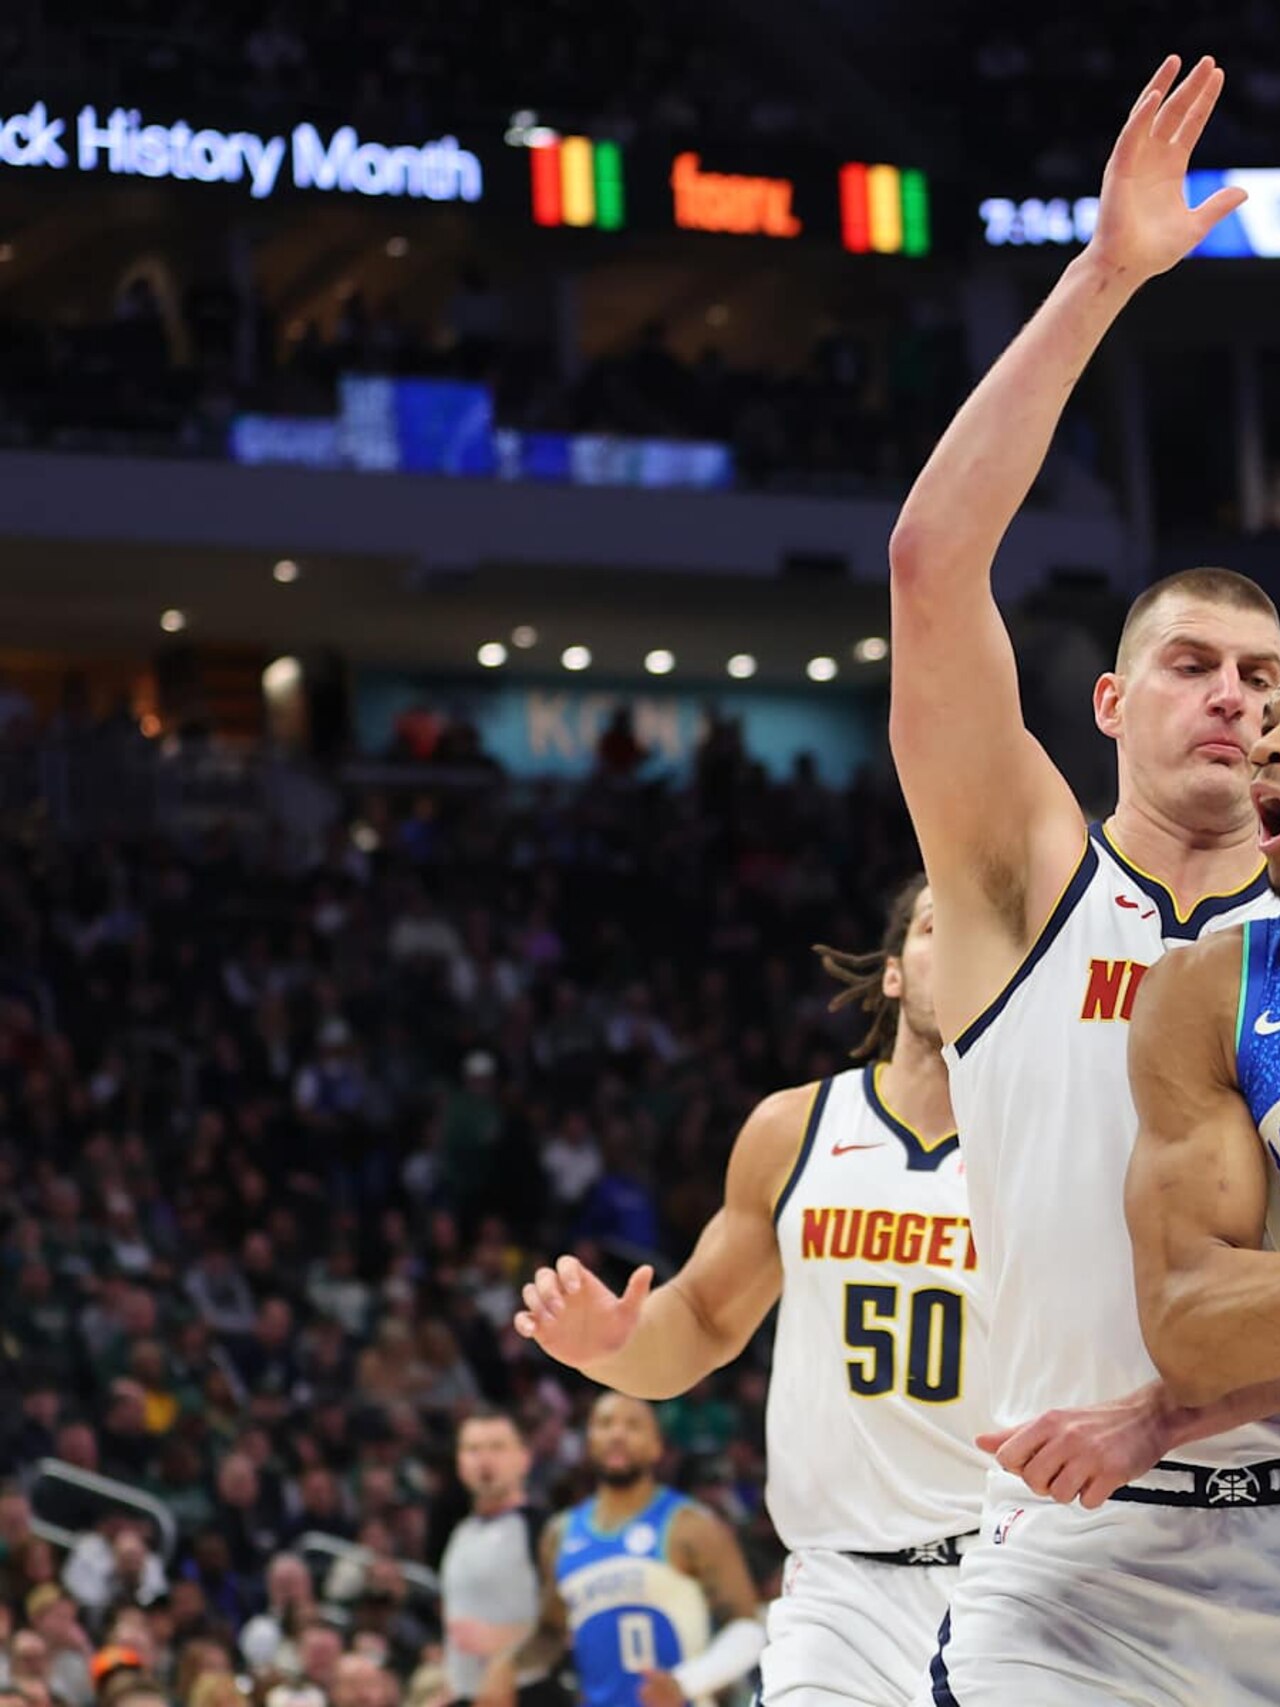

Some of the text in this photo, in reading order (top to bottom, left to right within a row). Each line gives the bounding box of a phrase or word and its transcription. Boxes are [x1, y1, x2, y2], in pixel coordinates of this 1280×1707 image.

[0, 101, 482, 203] ck History Month
[841, 1280, 967, 1407] 50
[616, 1613, 660, 1674] 0
